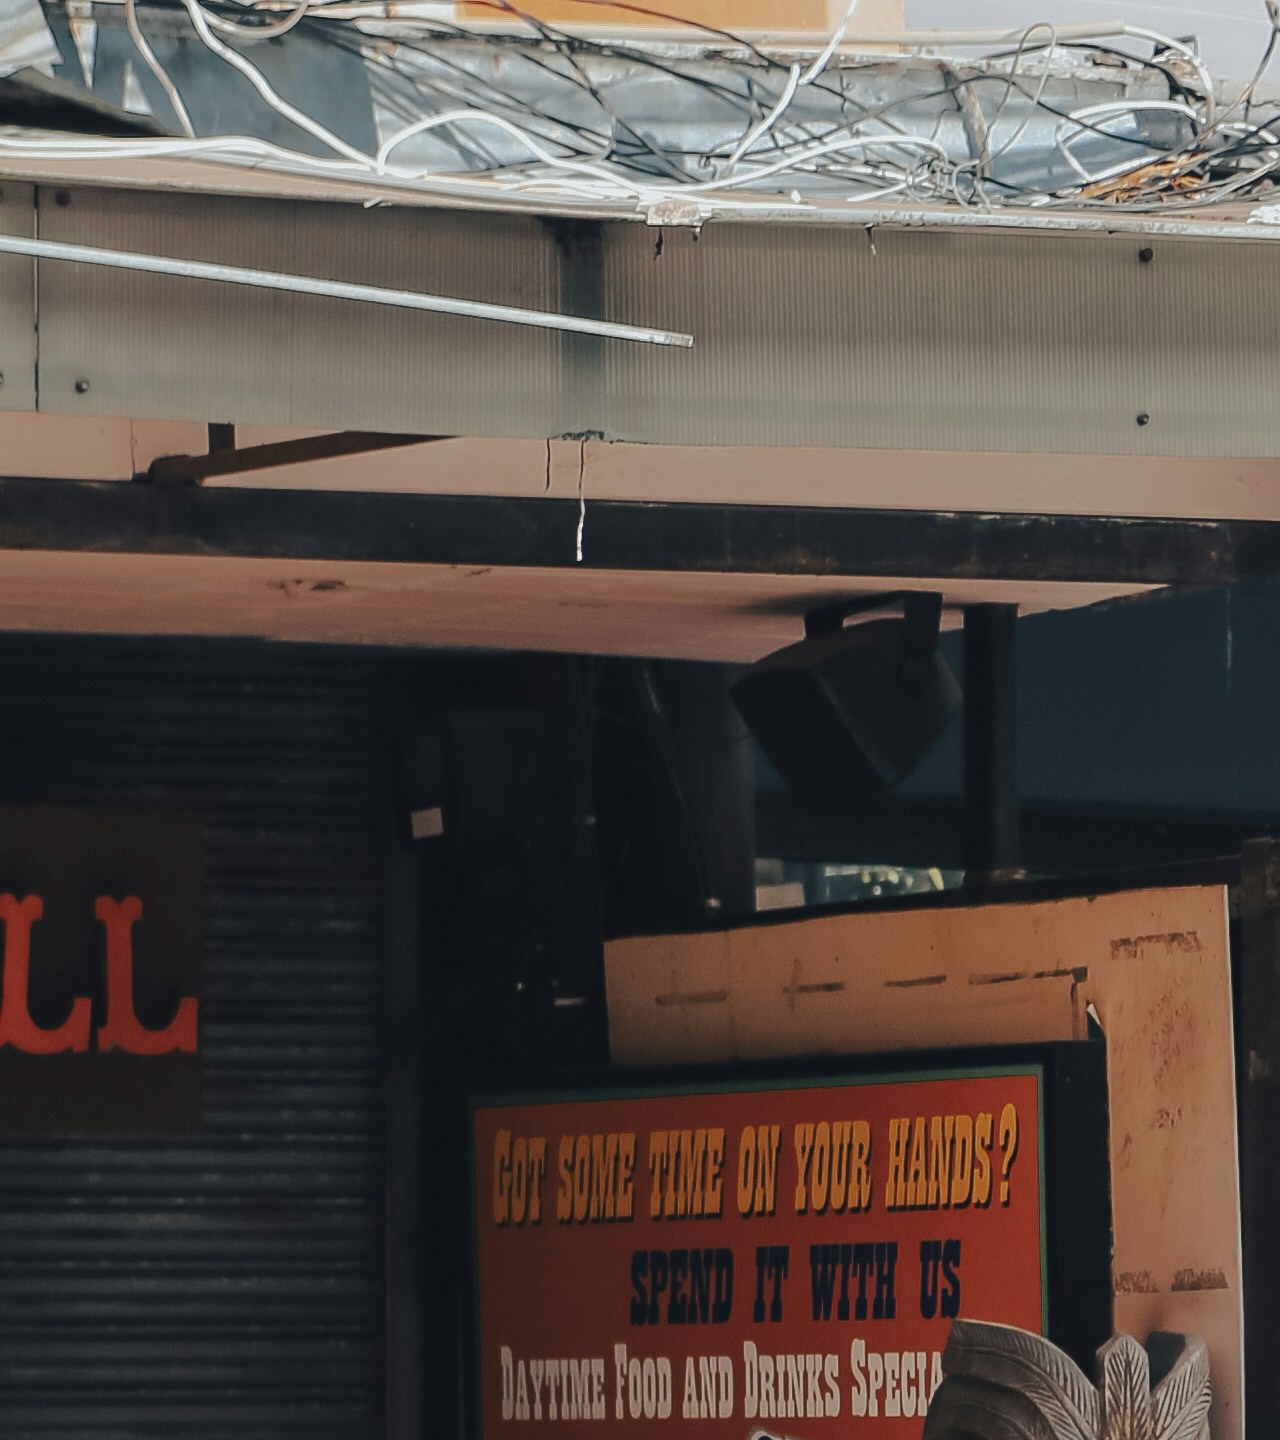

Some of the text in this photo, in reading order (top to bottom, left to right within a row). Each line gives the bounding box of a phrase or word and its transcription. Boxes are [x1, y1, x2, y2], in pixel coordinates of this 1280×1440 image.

[0, 893, 198, 1056] LL
[557, 1132, 636, 1222] SOME
[650, 1127, 725, 1220] TIME
[737, 1124, 782, 1217] ON
[794, 1120, 872, 1215] YOUR
[629, 1238, 962, 1325] SPEND IT WITH US
[683, 1356, 734, 1420] AND
